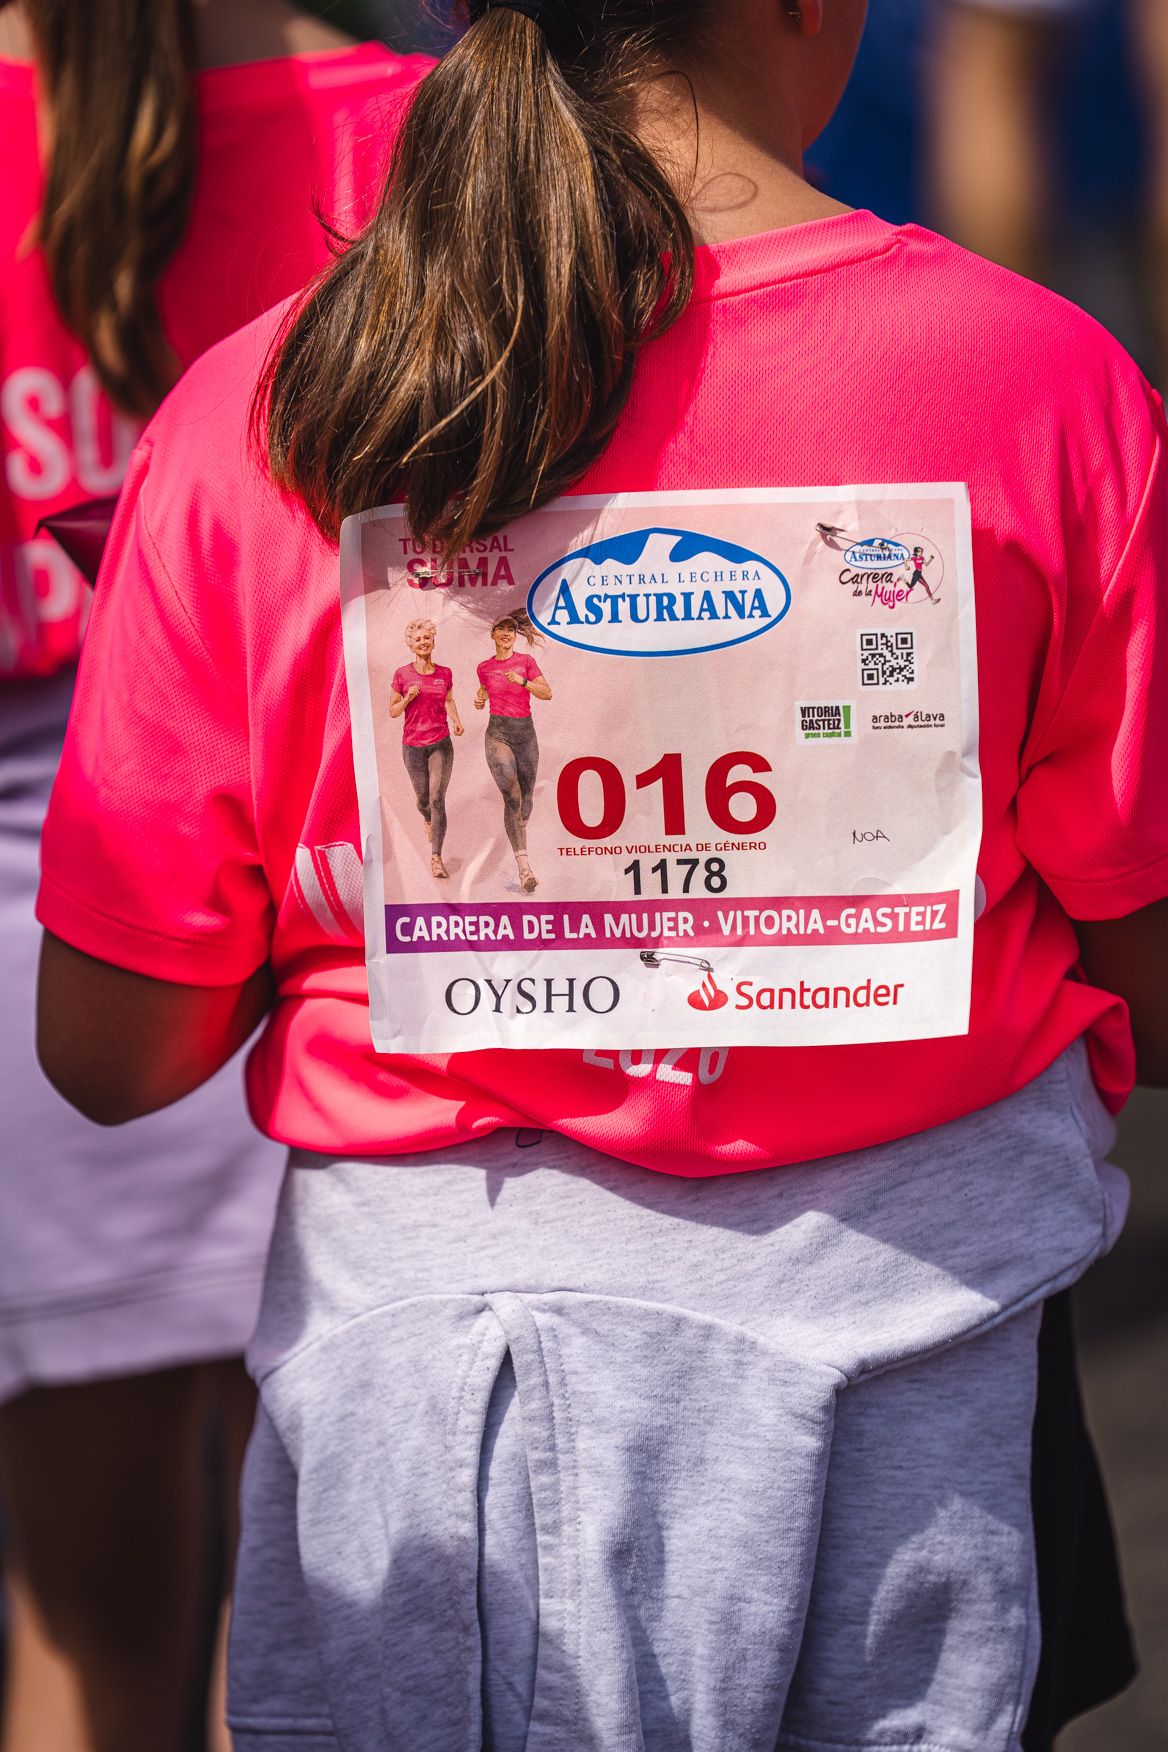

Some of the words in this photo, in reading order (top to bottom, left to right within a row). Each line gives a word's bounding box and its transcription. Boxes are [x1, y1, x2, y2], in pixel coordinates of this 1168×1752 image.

[399, 537, 427, 555] TU
[431, 535, 515, 555] DRSAL
[406, 556, 515, 589] SUMA
[586, 573, 669, 586] CENTRAL
[678, 570, 762, 582] LECHERA
[838, 568, 894, 585] Carrera
[547, 578, 772, 626] ASTURIANA
[852, 585, 863, 597] de
[864, 584, 872, 597] la
[871, 581, 913, 609] Mujer
[800, 706, 841, 718] VITORIA
[871, 712, 904, 723] araba
[913, 710, 945, 722] álava
[801, 718, 842, 731] GASTEIZ
[556, 751, 777, 841] 016
[558, 845, 622, 856] TELÉFONO
[625, 843, 692, 854] VIOLENCIA
[696, 842, 712, 852] DE
[715, 840, 767, 851] GÉNERO
[853, 829, 890, 844] NOA
[624, 857, 728, 895] 1178
[395, 915, 515, 942] CARRERA
[522, 915, 555, 940] DE
[563, 914, 596, 939] LA
[604, 911, 695, 938] MUJER
[717, 904, 947, 936] VITORIA-GASTEIZ
[444, 975, 621, 1015] OYSHO
[735, 978, 905, 1010] Santander
